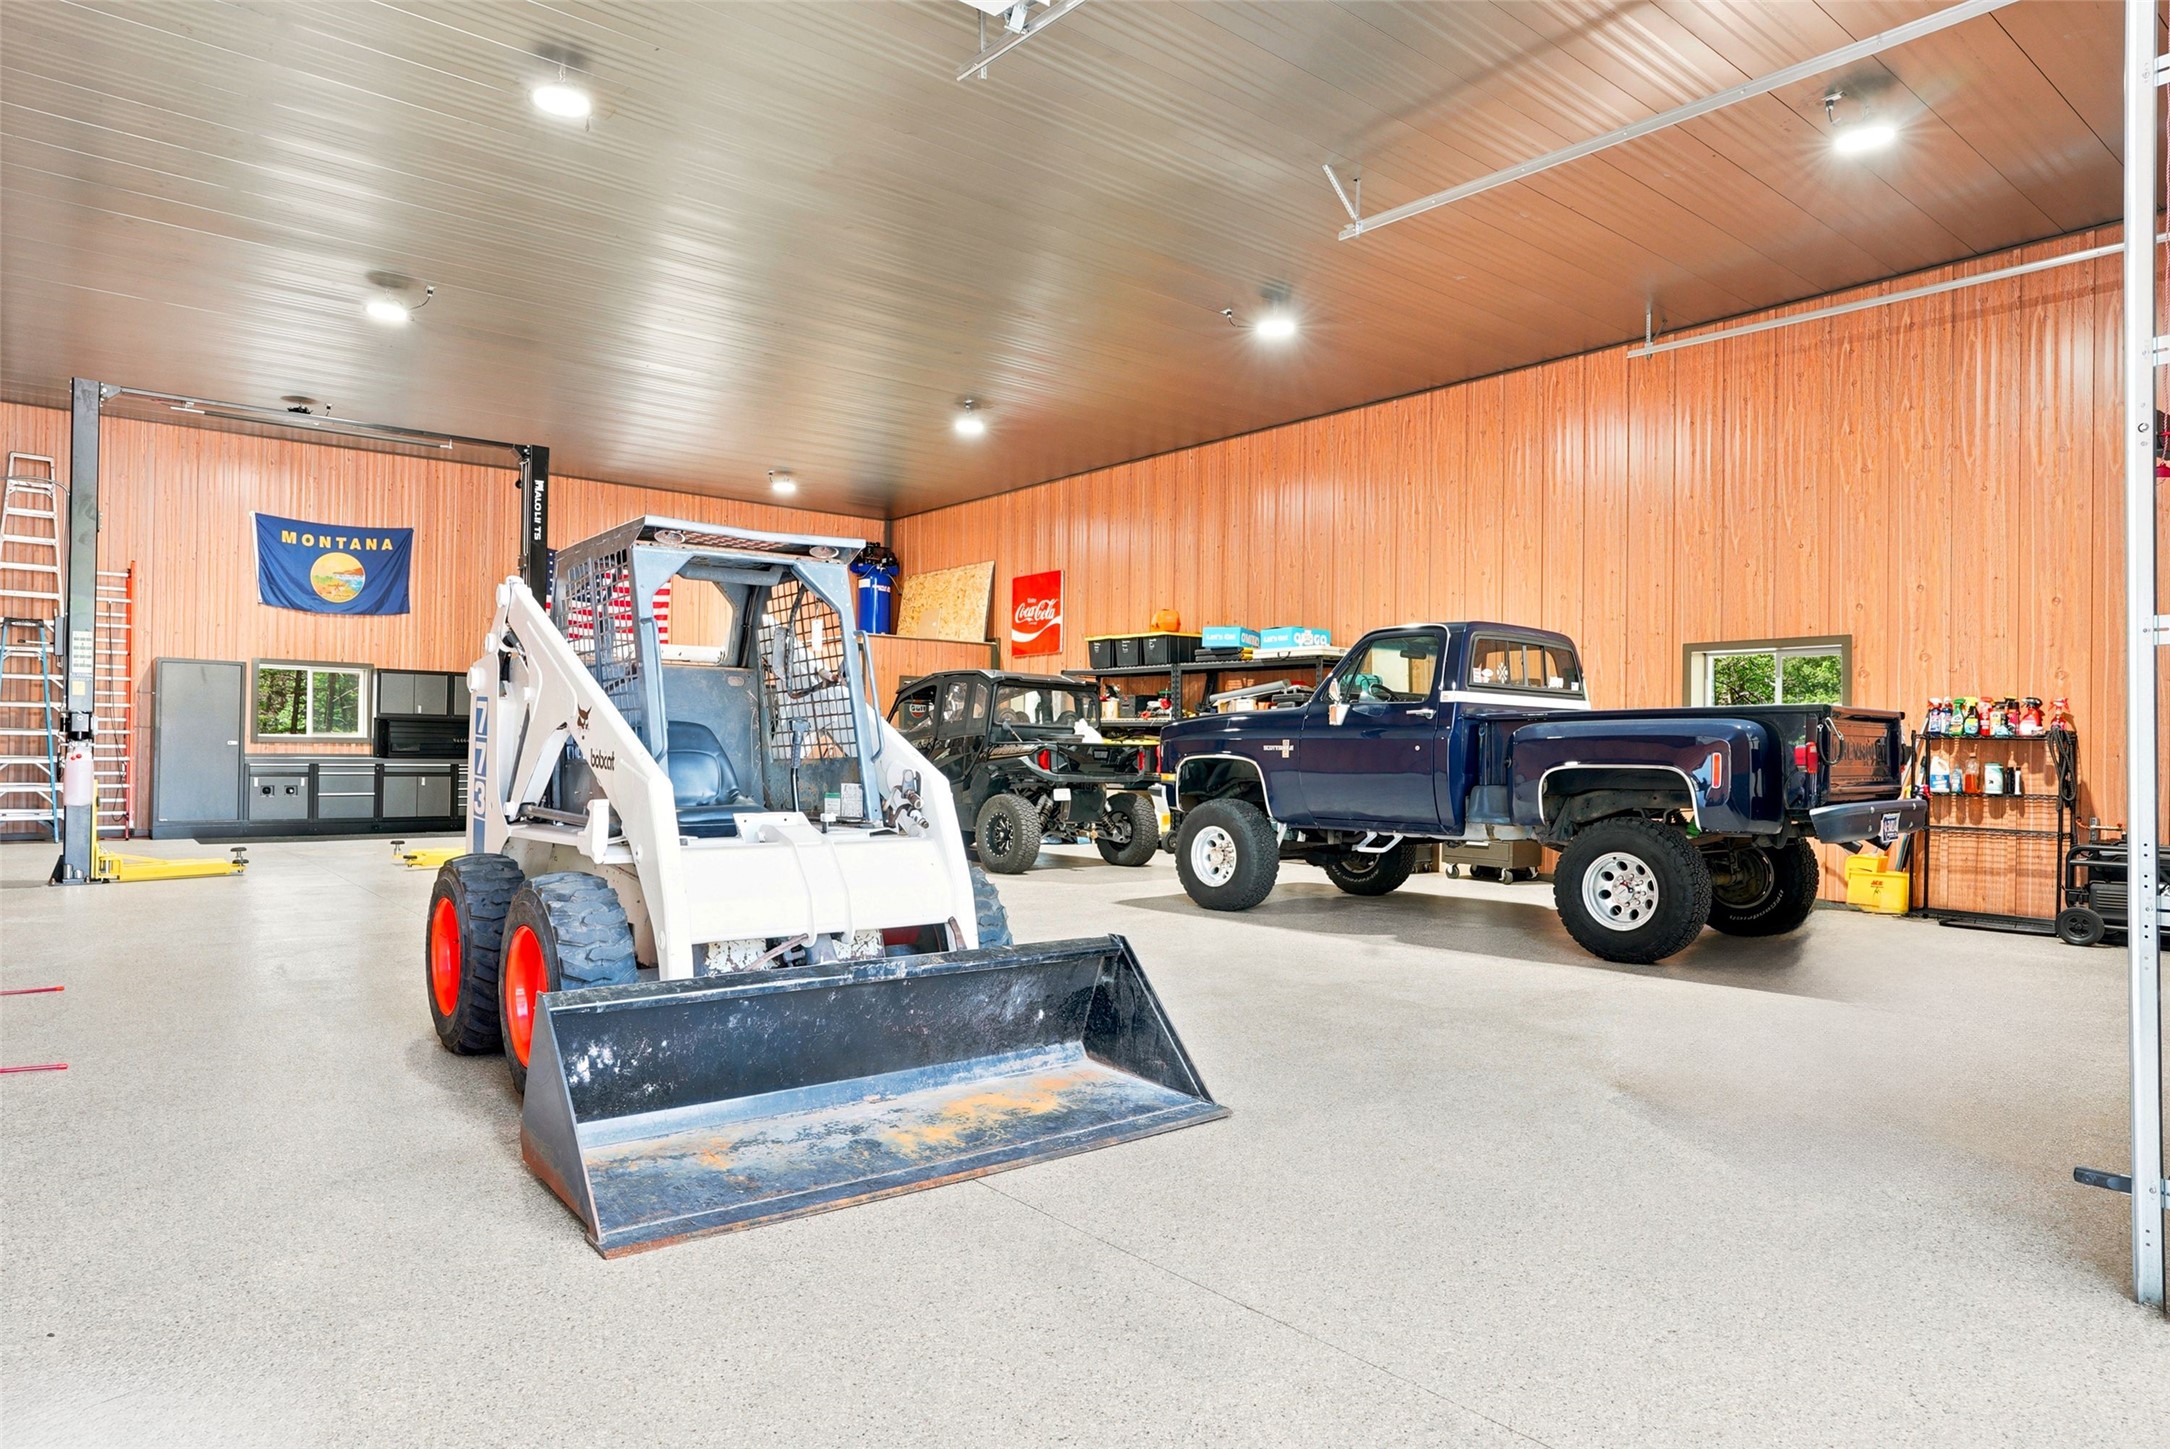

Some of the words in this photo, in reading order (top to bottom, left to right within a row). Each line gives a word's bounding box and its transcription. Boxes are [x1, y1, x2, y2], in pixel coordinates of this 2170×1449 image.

[281, 530, 393, 550] MONTANA
[474, 700, 488, 816] 773
[590, 748, 615, 771] bobcat
